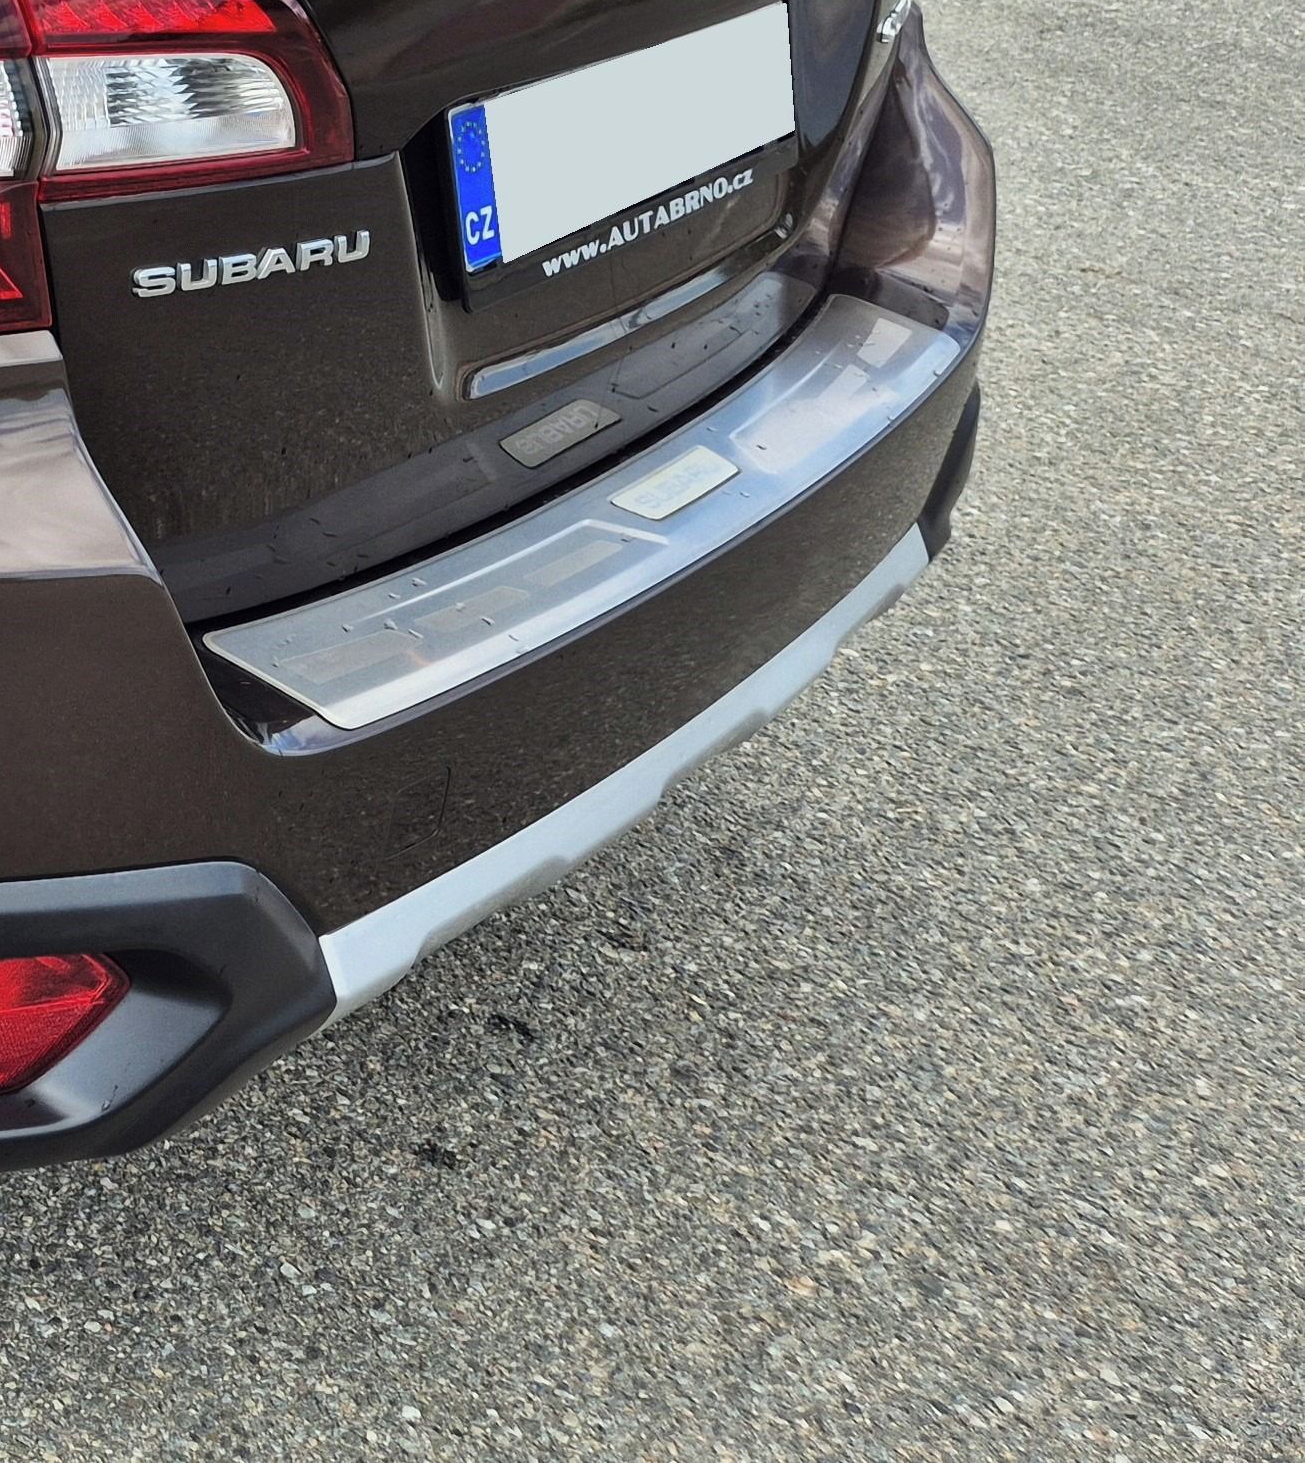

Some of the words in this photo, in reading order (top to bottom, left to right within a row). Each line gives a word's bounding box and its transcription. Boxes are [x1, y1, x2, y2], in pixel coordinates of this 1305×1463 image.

[464, 205, 496, 246] CZ
[541, 168, 754, 278] www.AUTABRNO.cz
[131, 229, 372, 299] SUBARU
